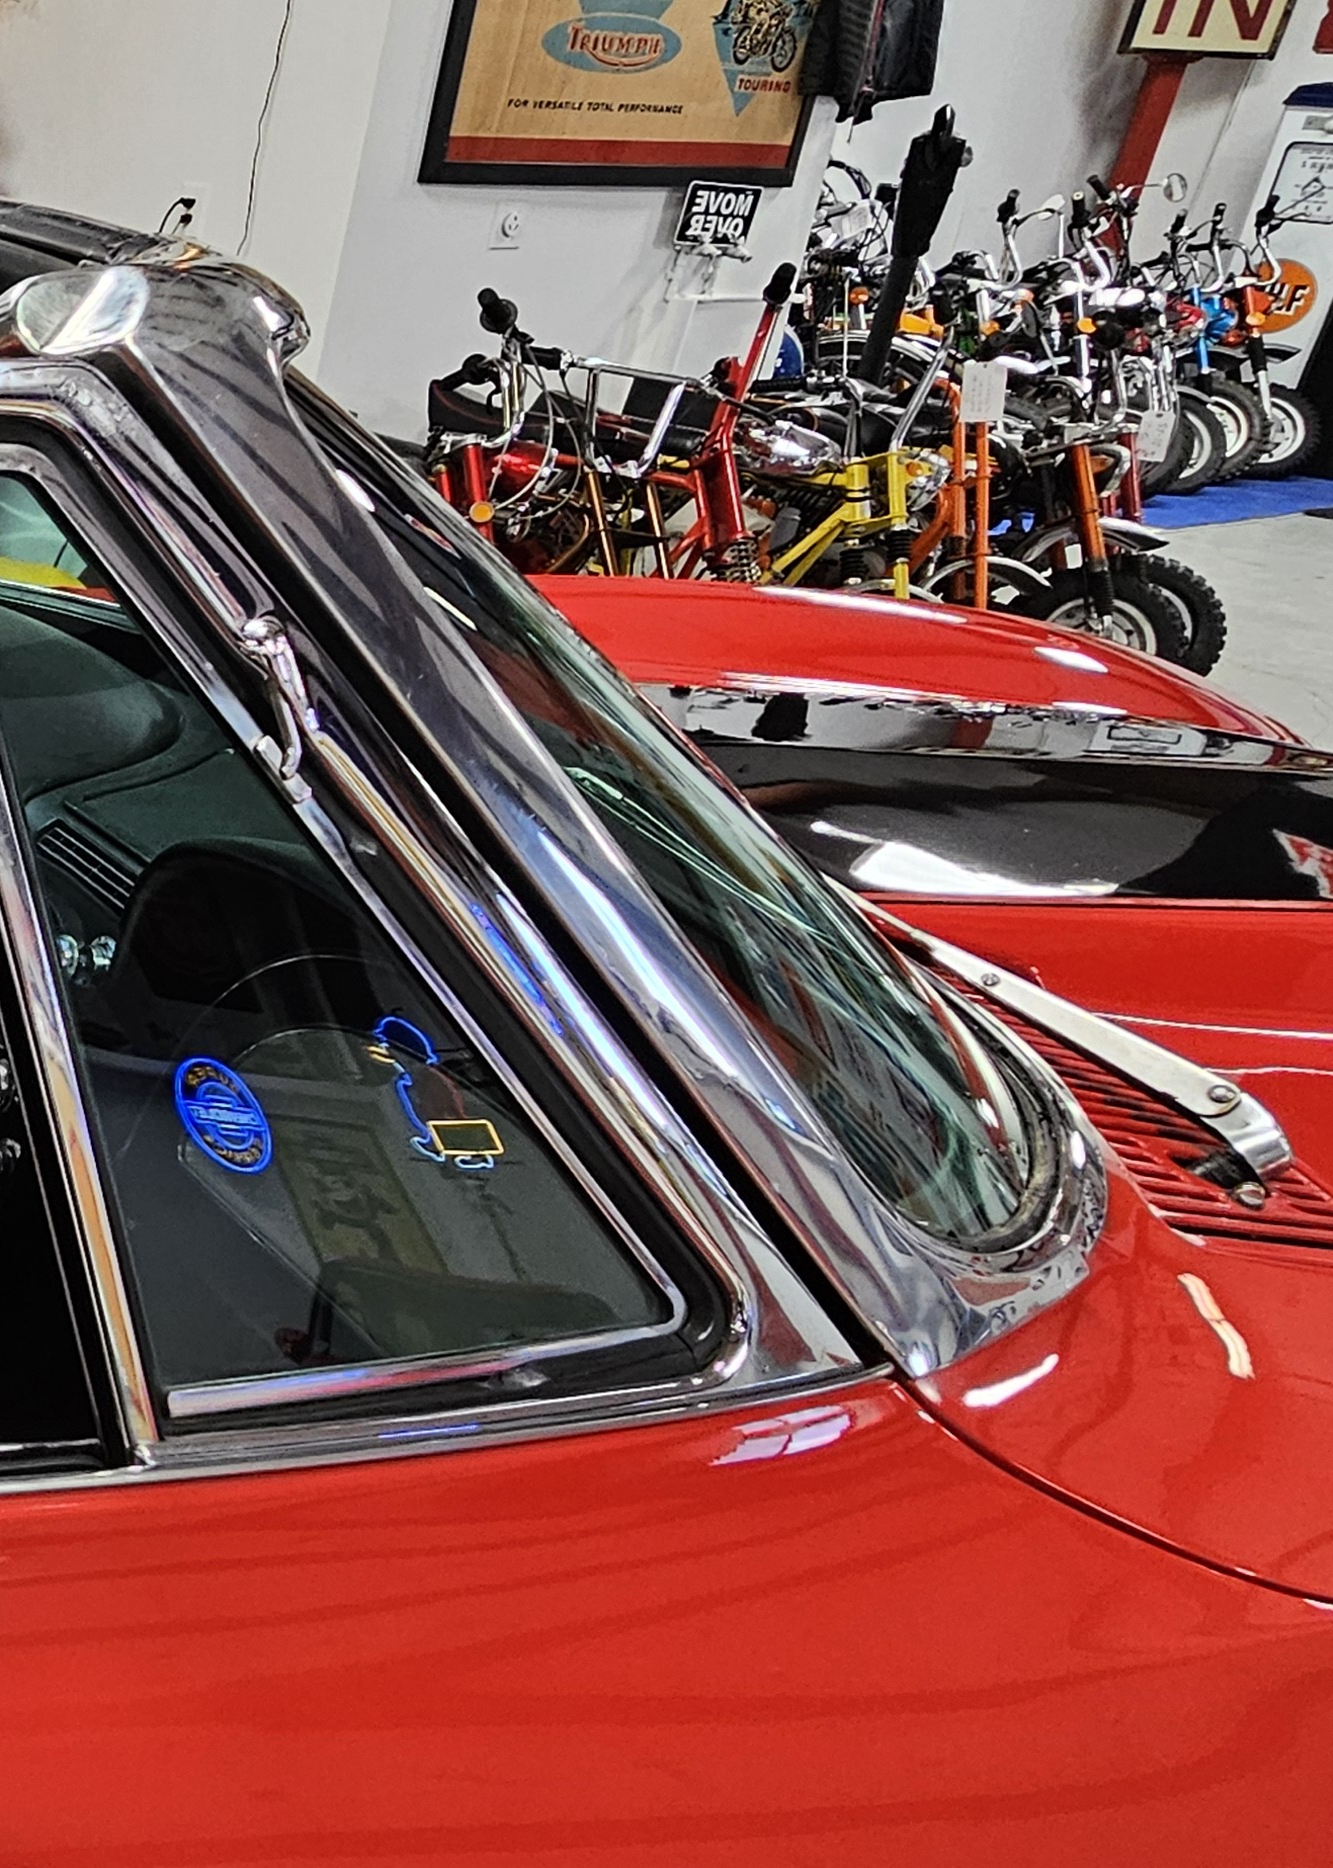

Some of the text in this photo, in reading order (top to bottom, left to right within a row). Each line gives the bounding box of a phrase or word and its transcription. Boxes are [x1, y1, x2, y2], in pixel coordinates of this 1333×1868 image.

[568, 24, 665, 66] TRIUMPH
[507, 99, 683, 114] FOR VERSATILE TOTAL PERFORMANCE
